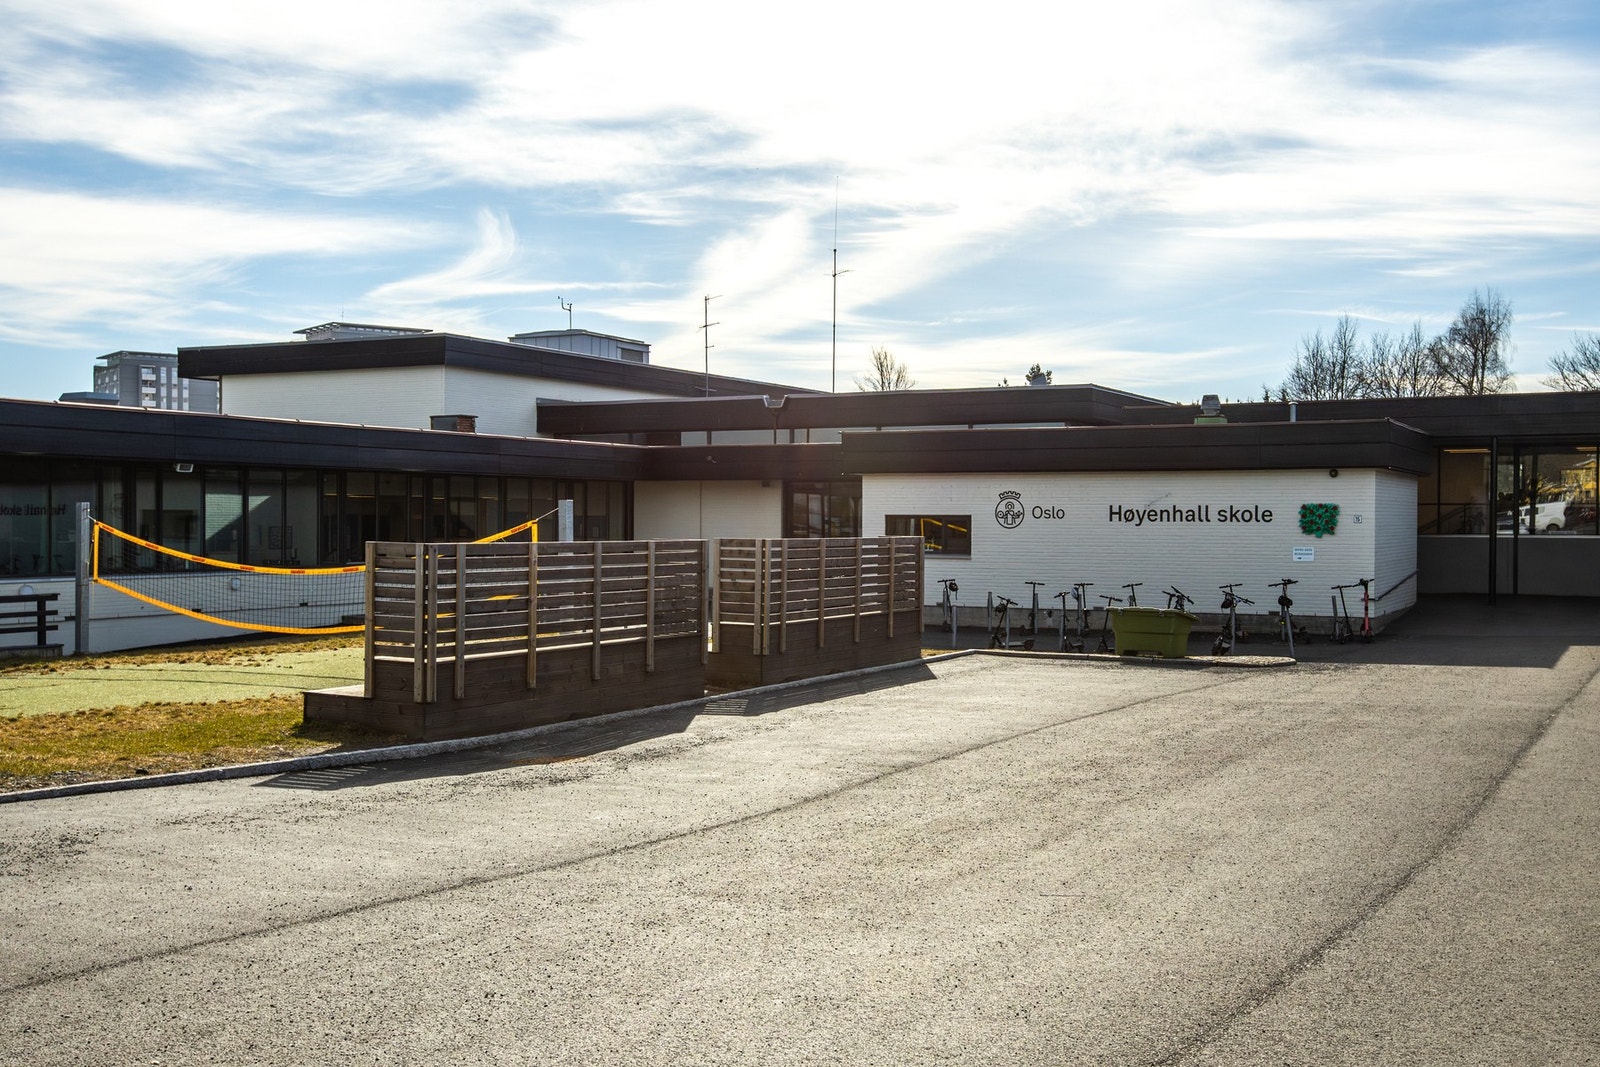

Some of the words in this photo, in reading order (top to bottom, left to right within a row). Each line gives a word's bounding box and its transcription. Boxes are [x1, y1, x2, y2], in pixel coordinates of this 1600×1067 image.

[1031, 505, 1066, 520] Oslo
[1108, 504, 1211, 527] Høyenhall
[1217, 504, 1273, 523] skole
